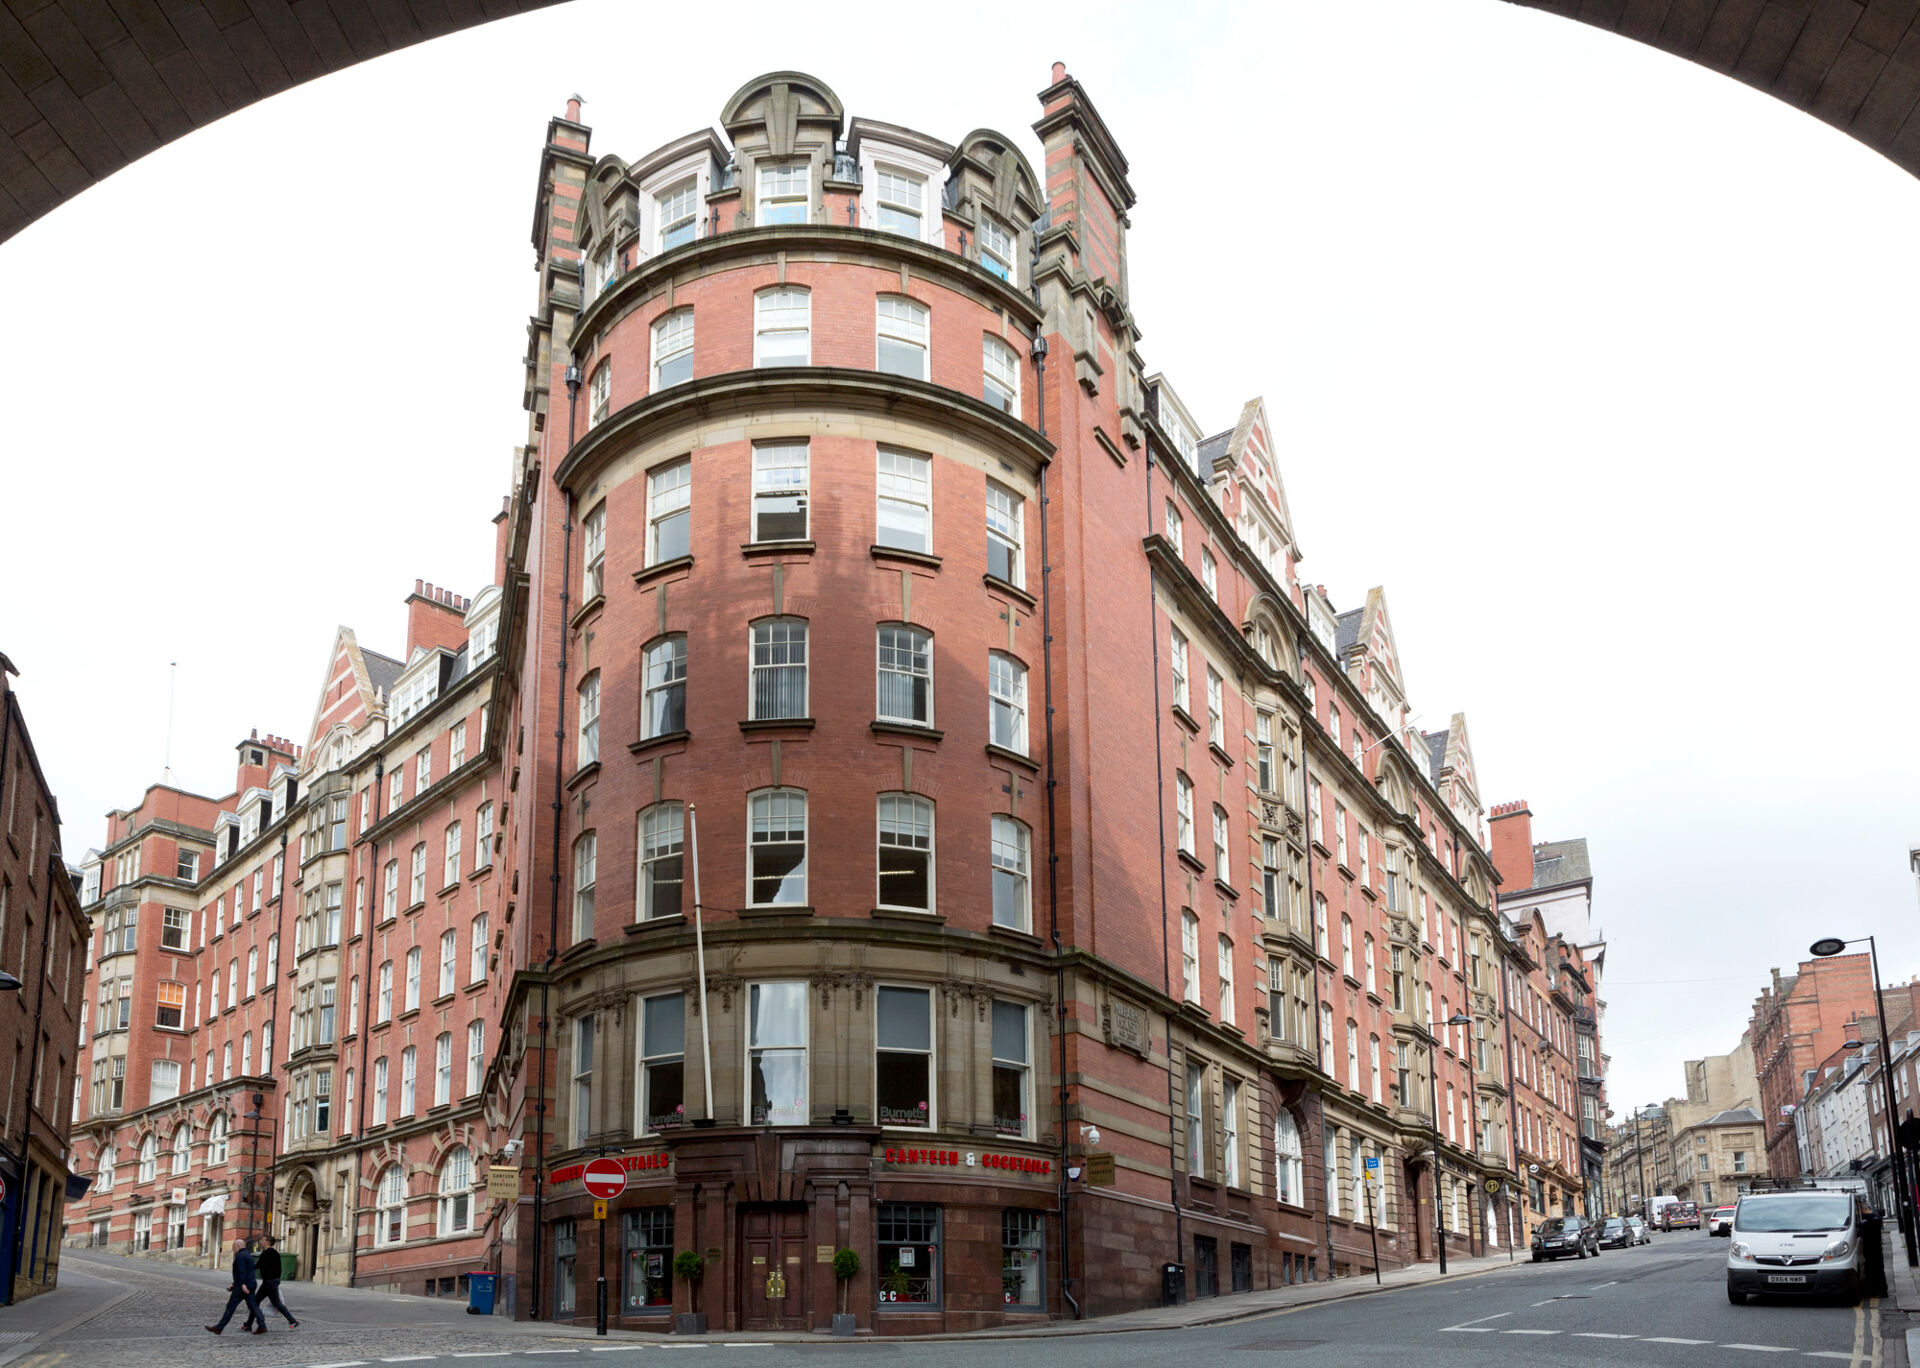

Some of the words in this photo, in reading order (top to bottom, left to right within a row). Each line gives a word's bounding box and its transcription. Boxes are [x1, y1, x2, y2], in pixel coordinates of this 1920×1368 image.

[880, 1105, 927, 1119] Burnetts
[885, 1148, 958, 1165] CANTEEN
[965, 1152, 975, 1167] &
[982, 1153, 1050, 1174] COCKTAILS
